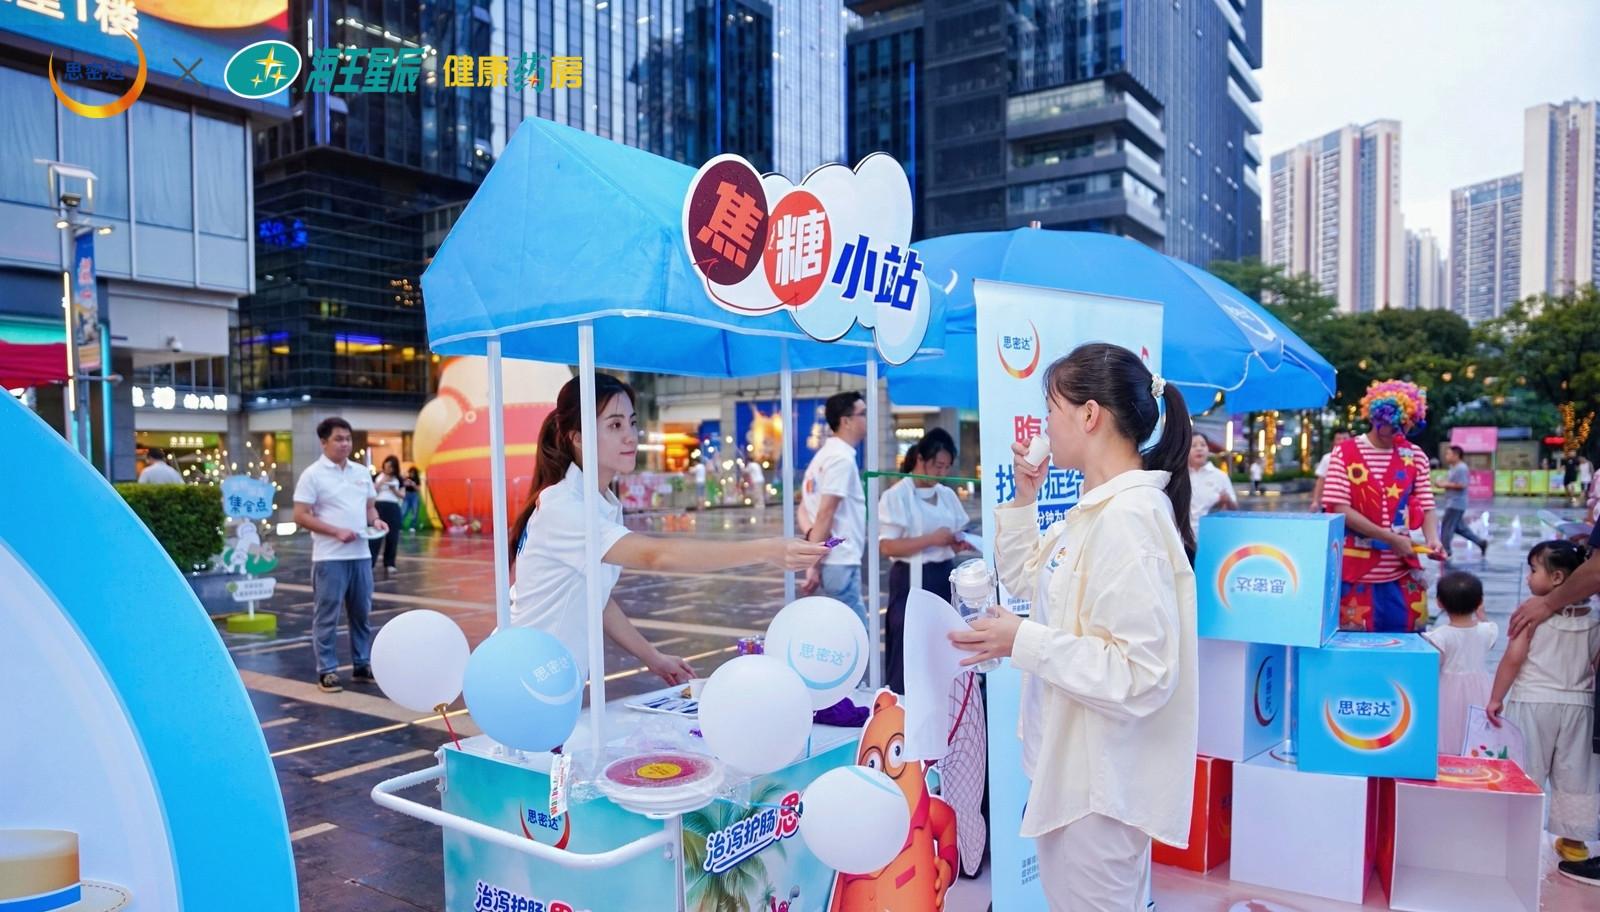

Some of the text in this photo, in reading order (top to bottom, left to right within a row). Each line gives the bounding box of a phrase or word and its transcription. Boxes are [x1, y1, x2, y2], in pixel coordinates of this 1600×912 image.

[696, 181, 922, 311] 焦糖小站
[1003, 335, 1031, 350] 思密达
[995, 463, 1085, 504] 找症结
[1234, 576, 1287, 594] 思密达
[799, 641, 846, 667] 思密达
[532, 655, 571, 683] 思密达
[1337, 700, 1391, 718] 思密达
[527, 808, 560, 831] 思密达
